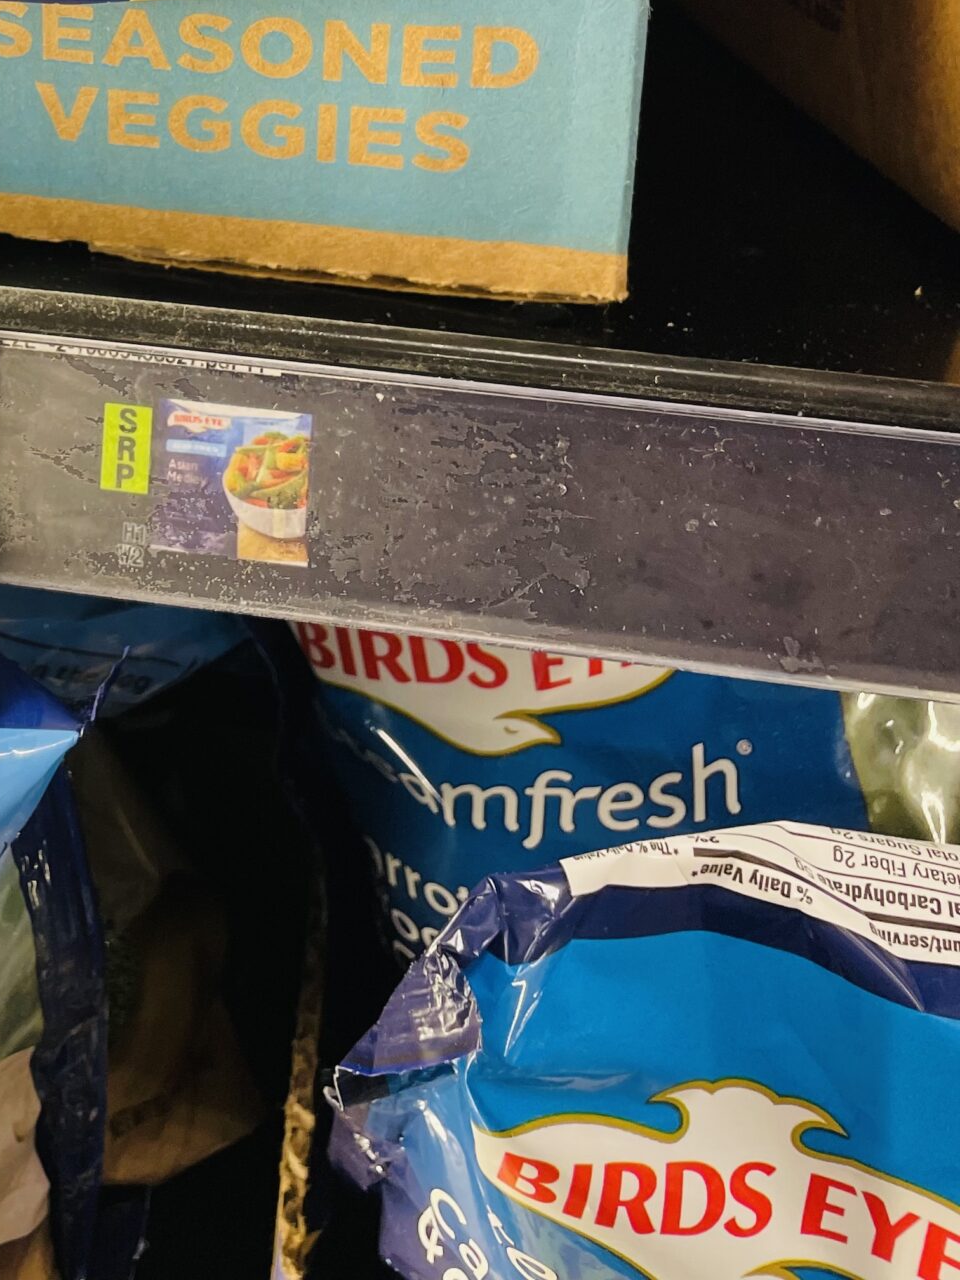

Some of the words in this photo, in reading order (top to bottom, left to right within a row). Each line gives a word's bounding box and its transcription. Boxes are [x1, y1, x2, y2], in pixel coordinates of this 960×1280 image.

[36, 81, 472, 173] VEGGIES
[833, 845, 856, 869] 2g
[860, 833, 921, 856] Sugars
[861, 854, 907, 878] Fiber
[749, 870, 792, 899] Daily
[817, 872, 941, 916] Carbohydrate
[497, 1151, 776, 1239] BIRDS
